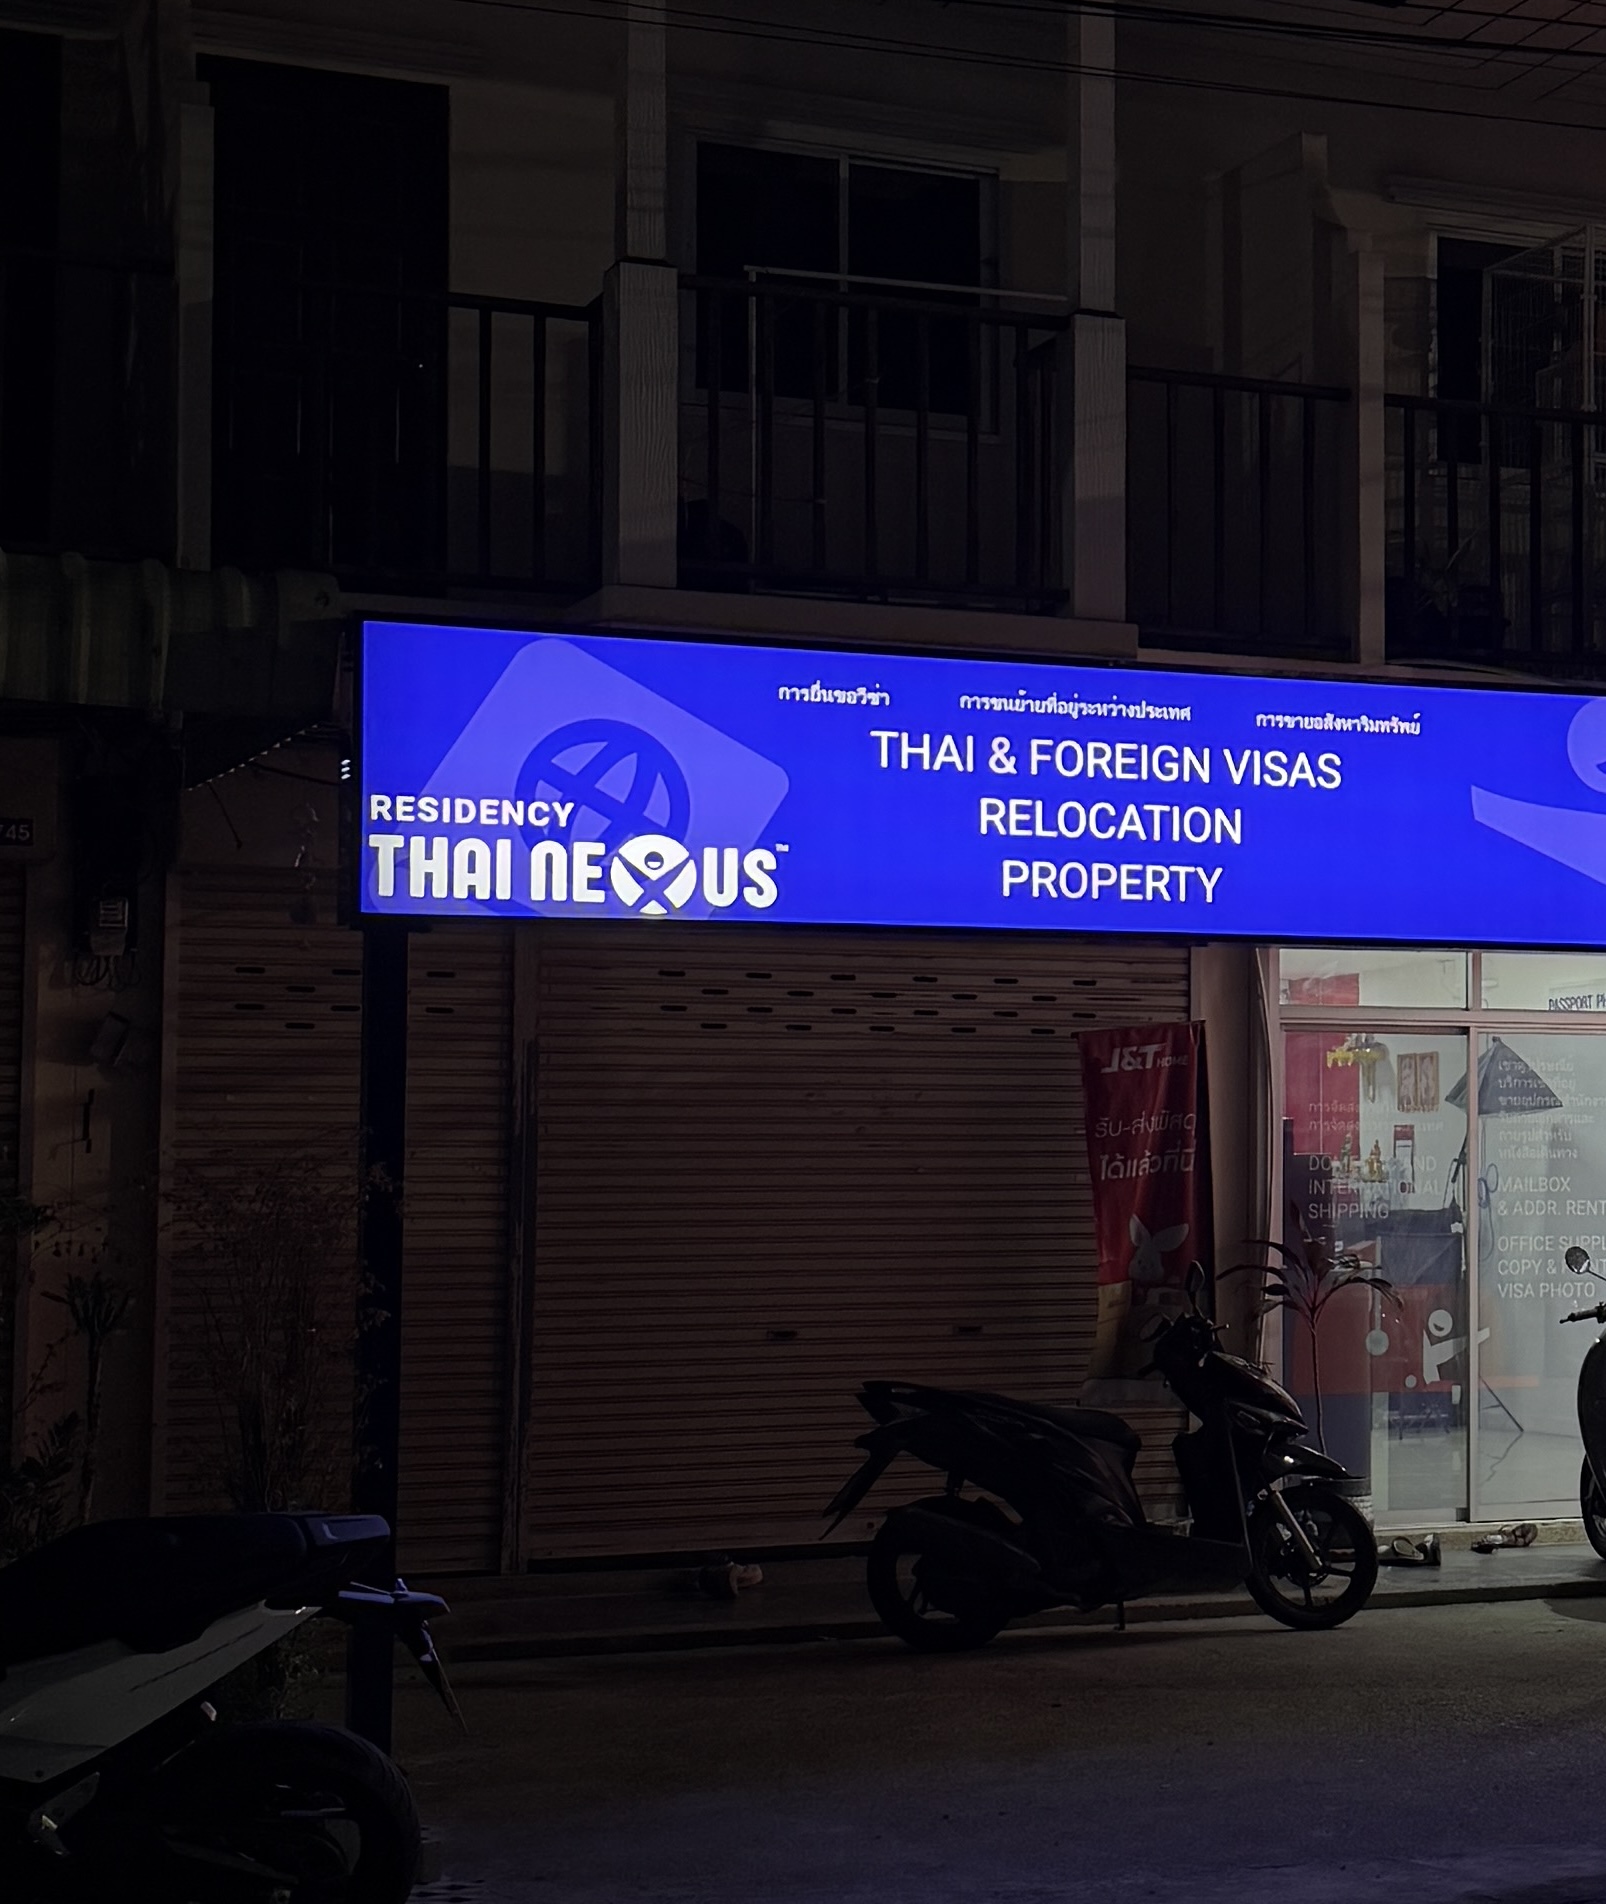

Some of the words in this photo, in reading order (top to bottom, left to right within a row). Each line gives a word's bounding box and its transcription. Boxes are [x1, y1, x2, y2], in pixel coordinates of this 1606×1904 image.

[870, 730, 975, 773] THAI
[989, 736, 1018, 776] &
[1030, 738, 1210, 785] FOREIGN
[1224, 748, 1342, 791] VISAS
[369, 795, 575, 828] RESIDENCY
[980, 798, 1242, 845] RELOCATION
[369, 834, 512, 901] THAI
[527, 834, 779, 916] NEXUS
[1002, 861, 1223, 905] PROPERTY
[1100, 1042, 1167, 1074] J&T
[1156, 1054, 1189, 1068] HOME
[1498, 1176, 1571, 1193] MAILBOX
[1308, 1203, 1389, 1219] SHIPPING
[1498, 1200, 1507, 1216] &
[1512, 1200, 1561, 1216] ADDR.
[1498, 1236, 1554, 1252] OFFICE
[1498, 1259, 1542, 1275] COPY
[1547, 1260, 1556, 1275] &
[1498, 1283, 1535, 1298] VISA
[1540, 1282, 1596, 1298] PHOTO
